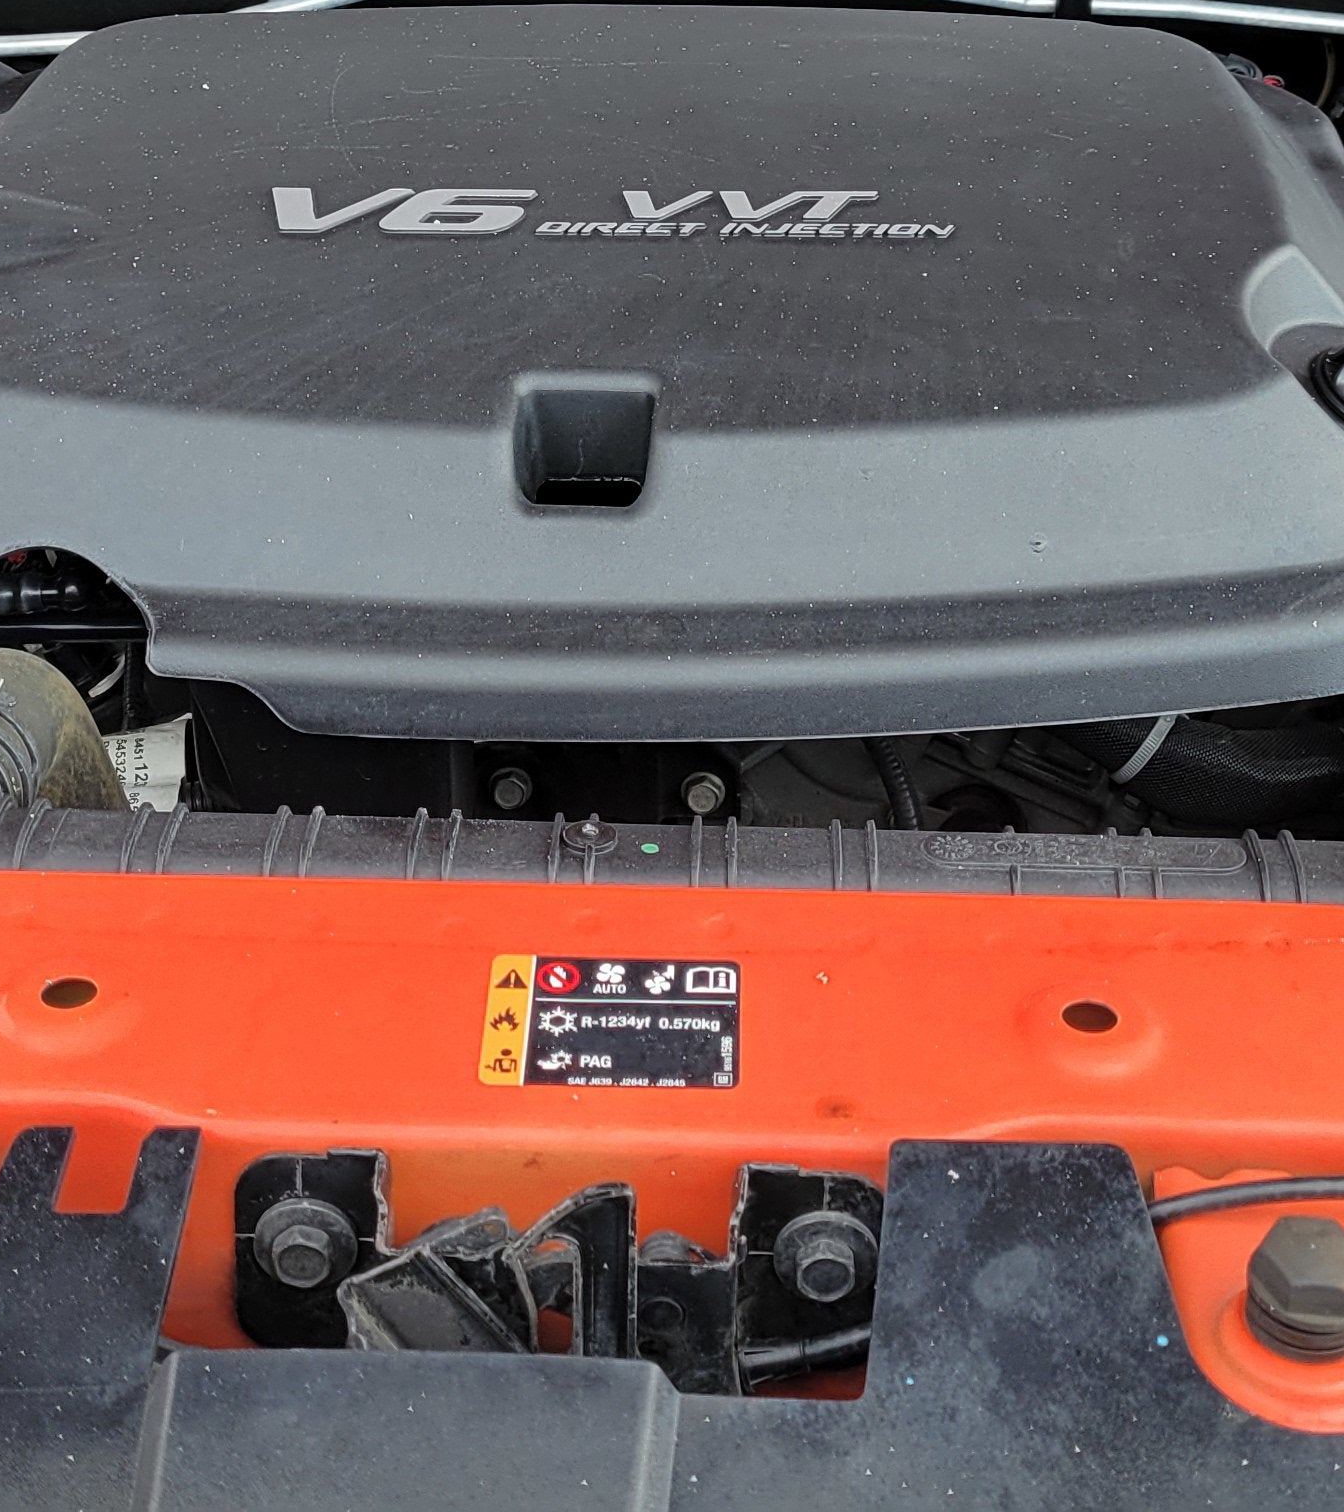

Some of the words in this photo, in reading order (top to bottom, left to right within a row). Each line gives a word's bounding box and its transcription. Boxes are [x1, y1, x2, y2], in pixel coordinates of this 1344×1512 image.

[271, 187, 538, 236] V6
[623, 190, 881, 222] VVT
[535, 220, 709, 239] DIRECT
[720, 220, 957, 240] INJECTION
[593, 983, 627, 995] AUTO
[580, 1016, 651, 1031] R-1234yf
[658, 1017, 721, 1032] 0.570kg
[580, 1055, 612, 1068] PAG
